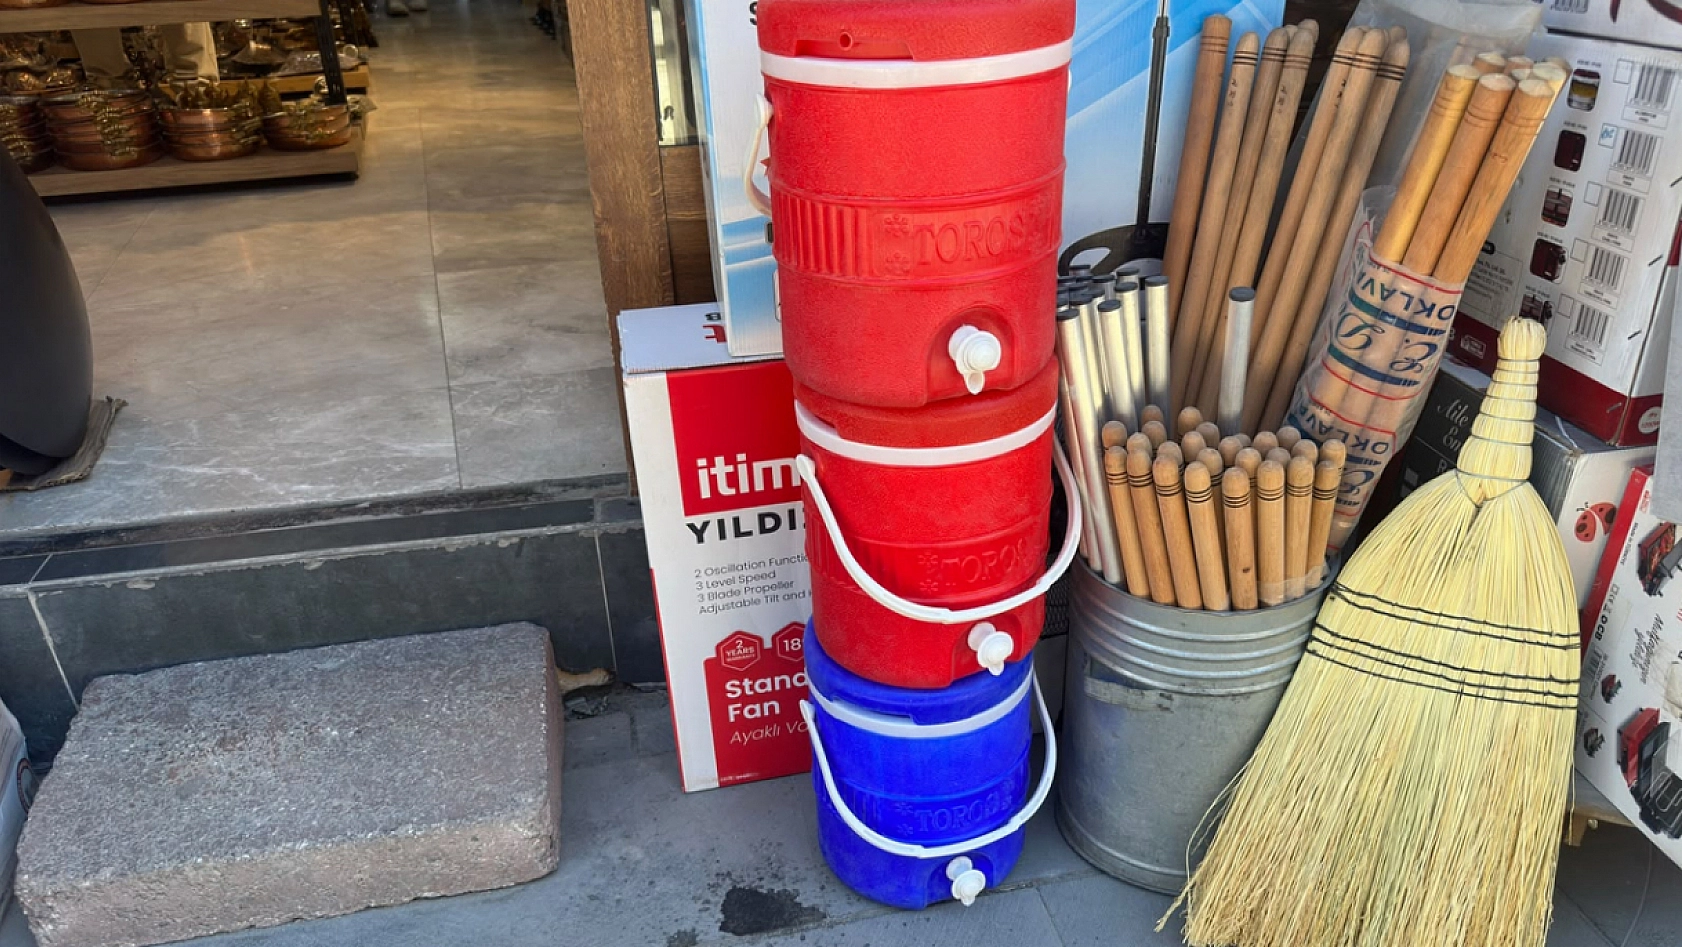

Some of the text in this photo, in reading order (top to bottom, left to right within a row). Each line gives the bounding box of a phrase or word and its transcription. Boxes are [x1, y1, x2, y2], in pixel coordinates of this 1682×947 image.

[912, 212, 1026, 267] TOROS
[686, 508, 806, 545] YILDI
[694, 569, 702, 578] 2
[704, 560, 766, 577] Oscillation
[696, 570, 776, 591] 3 Level Speed
[697, 580, 794, 602] 3 Blade Propeller
[699, 589, 806, 615] Adjustable Tilt and
[725, 646, 755, 658] YEARS
[735, 639, 743, 649] 2
[783, 638, 805, 653] 18
[727, 700, 780, 723] Fan
